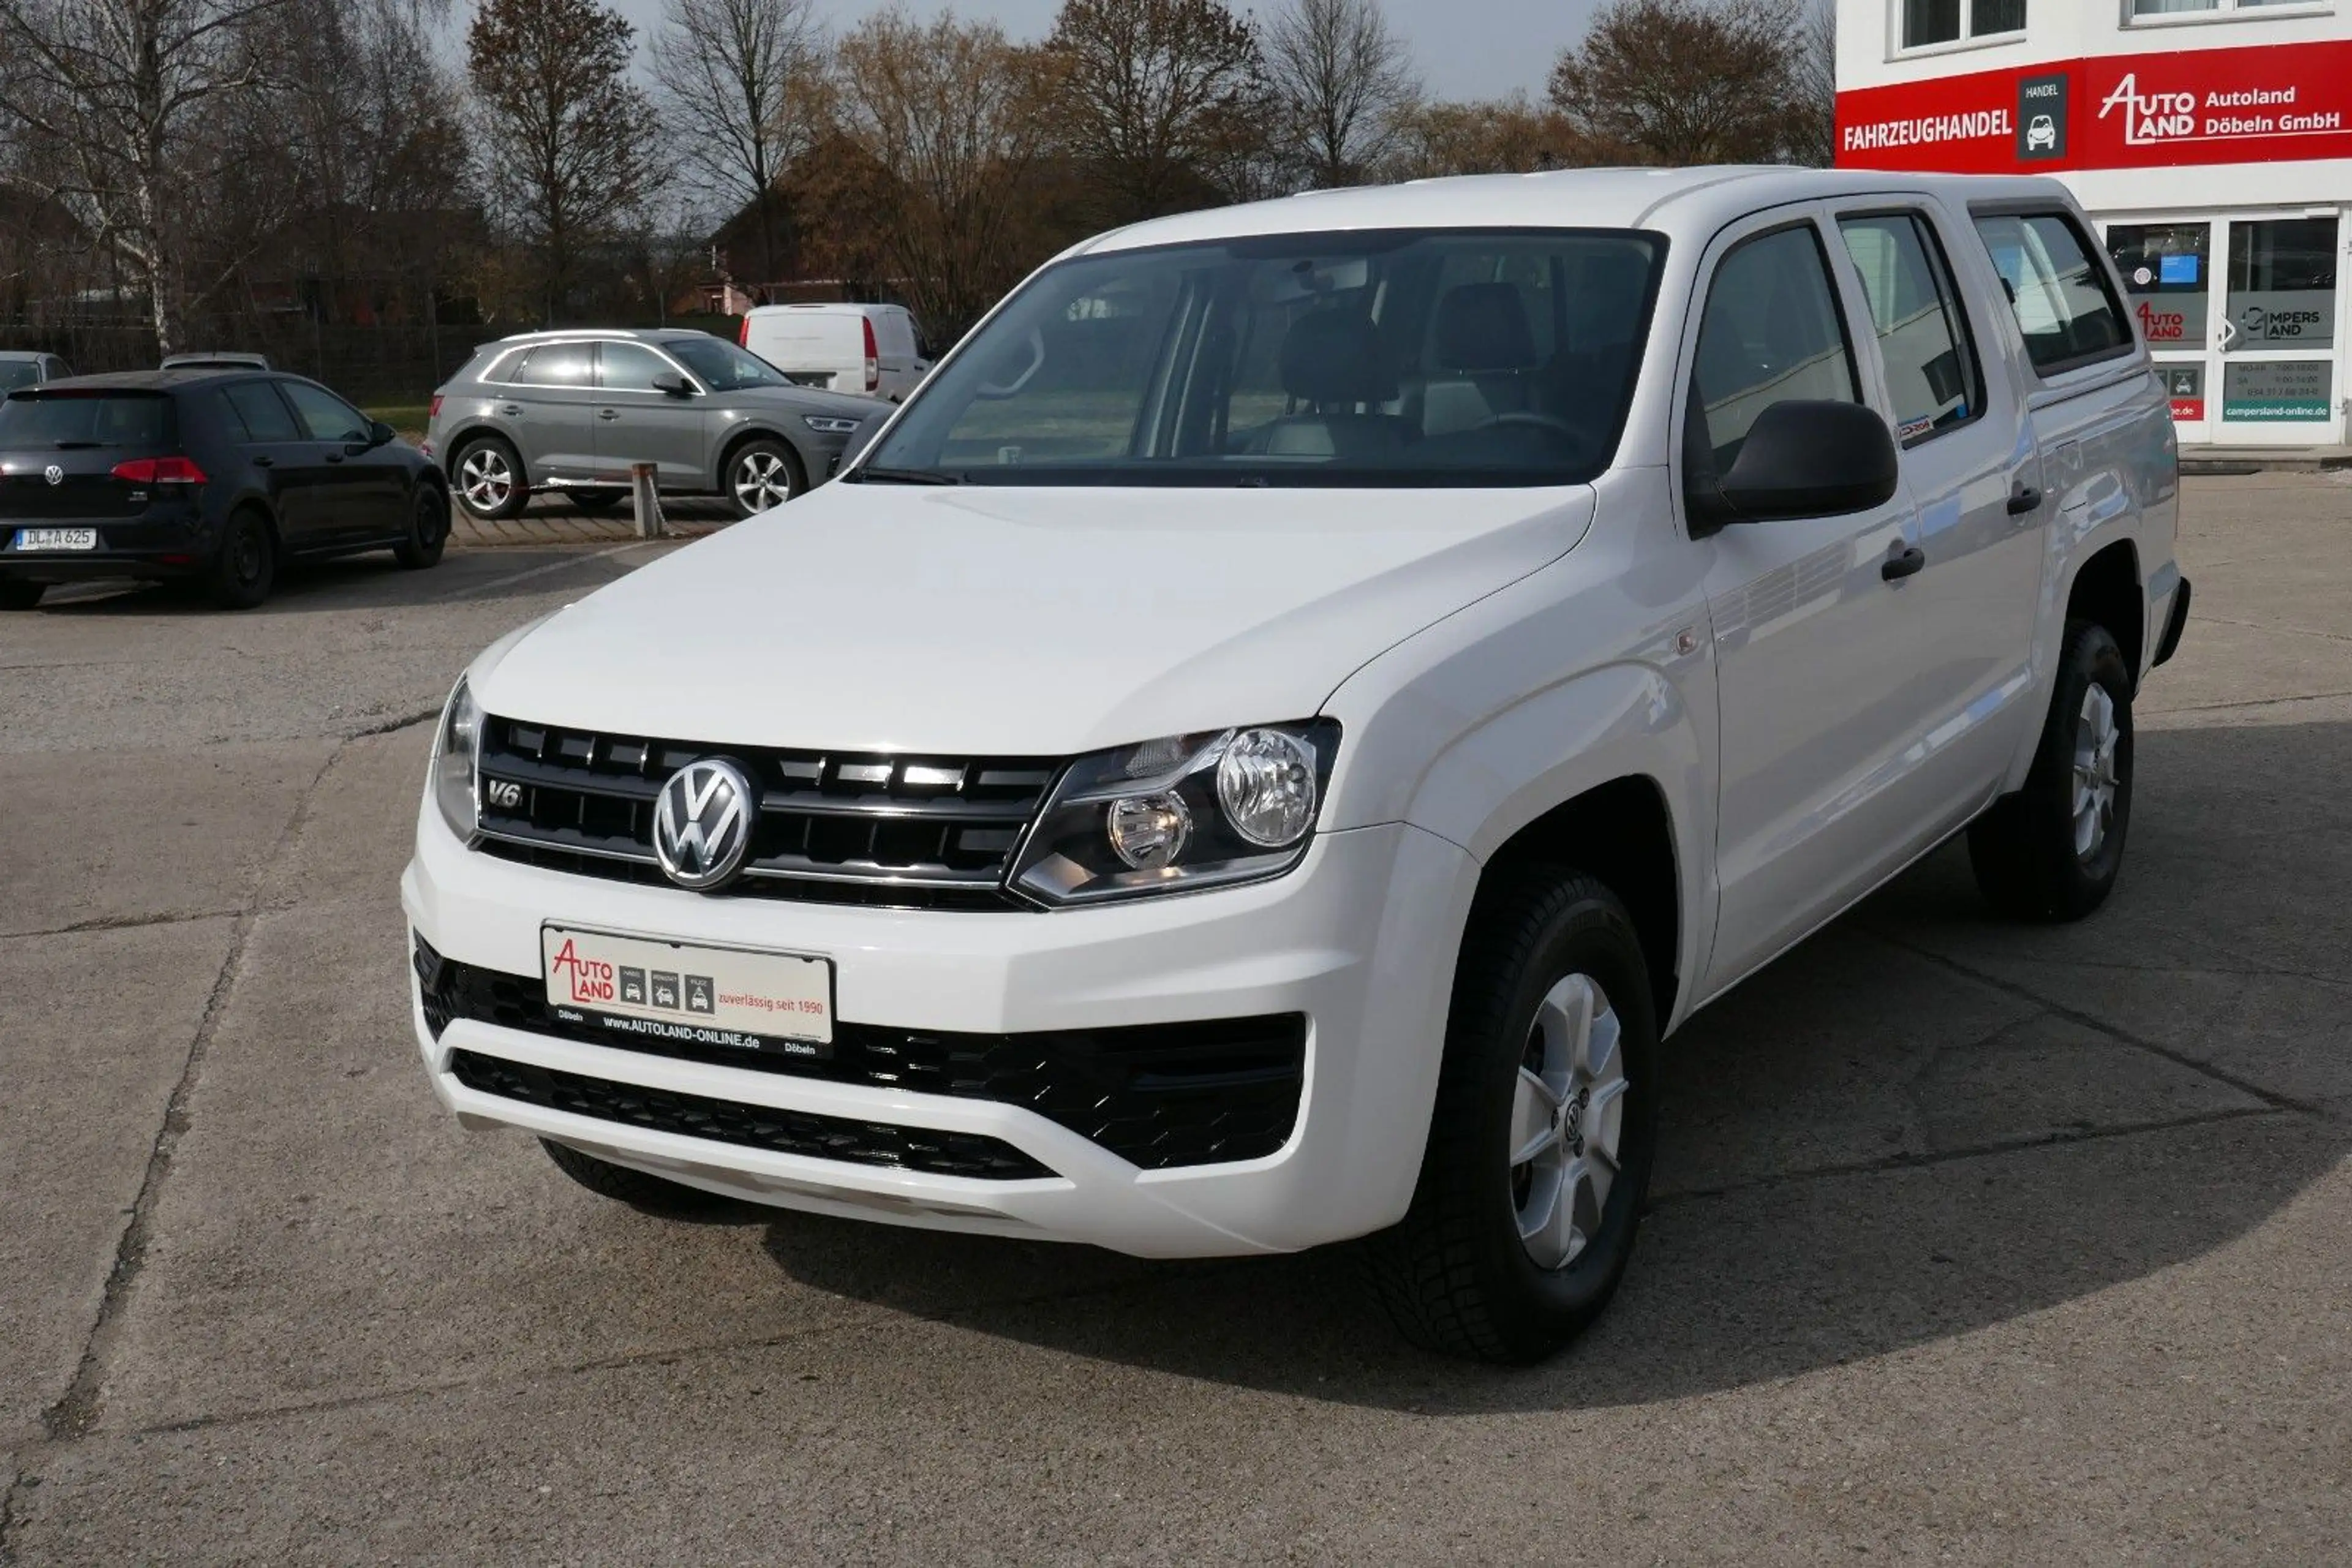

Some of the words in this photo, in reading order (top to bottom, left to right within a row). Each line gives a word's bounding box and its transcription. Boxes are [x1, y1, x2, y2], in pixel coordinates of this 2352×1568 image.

[2026, 84, 2058, 98] HANDEL
[2098, 74, 2195, 118] AUTO
[2205, 86, 2296, 107] Autoland
[1844, 109, 2012, 151] FAHRZEUGHANDEL
[2206, 115, 2273, 134] Döbeln
[2278, 112, 2340, 131] GmbH
[2226, 407, 2328, 417] campersland-online.de
[28, 530, 45, 544] DL
[55, 530, 62, 543] A
[65, 530, 89, 543] 625
[490, 779, 522, 807] V6
[553, 938, 612, 981] AUTO
[571, 979, 614, 1003] LAND
[718, 993, 774, 1011] zuverlässig
[776, 999, 795, 1011] seit
[798, 1000, 823, 1014] 1990
[603, 1017, 760, 1049] www.AUTOLAND-ONLINE.de
[785, 1042, 816, 1055] Döbeln
